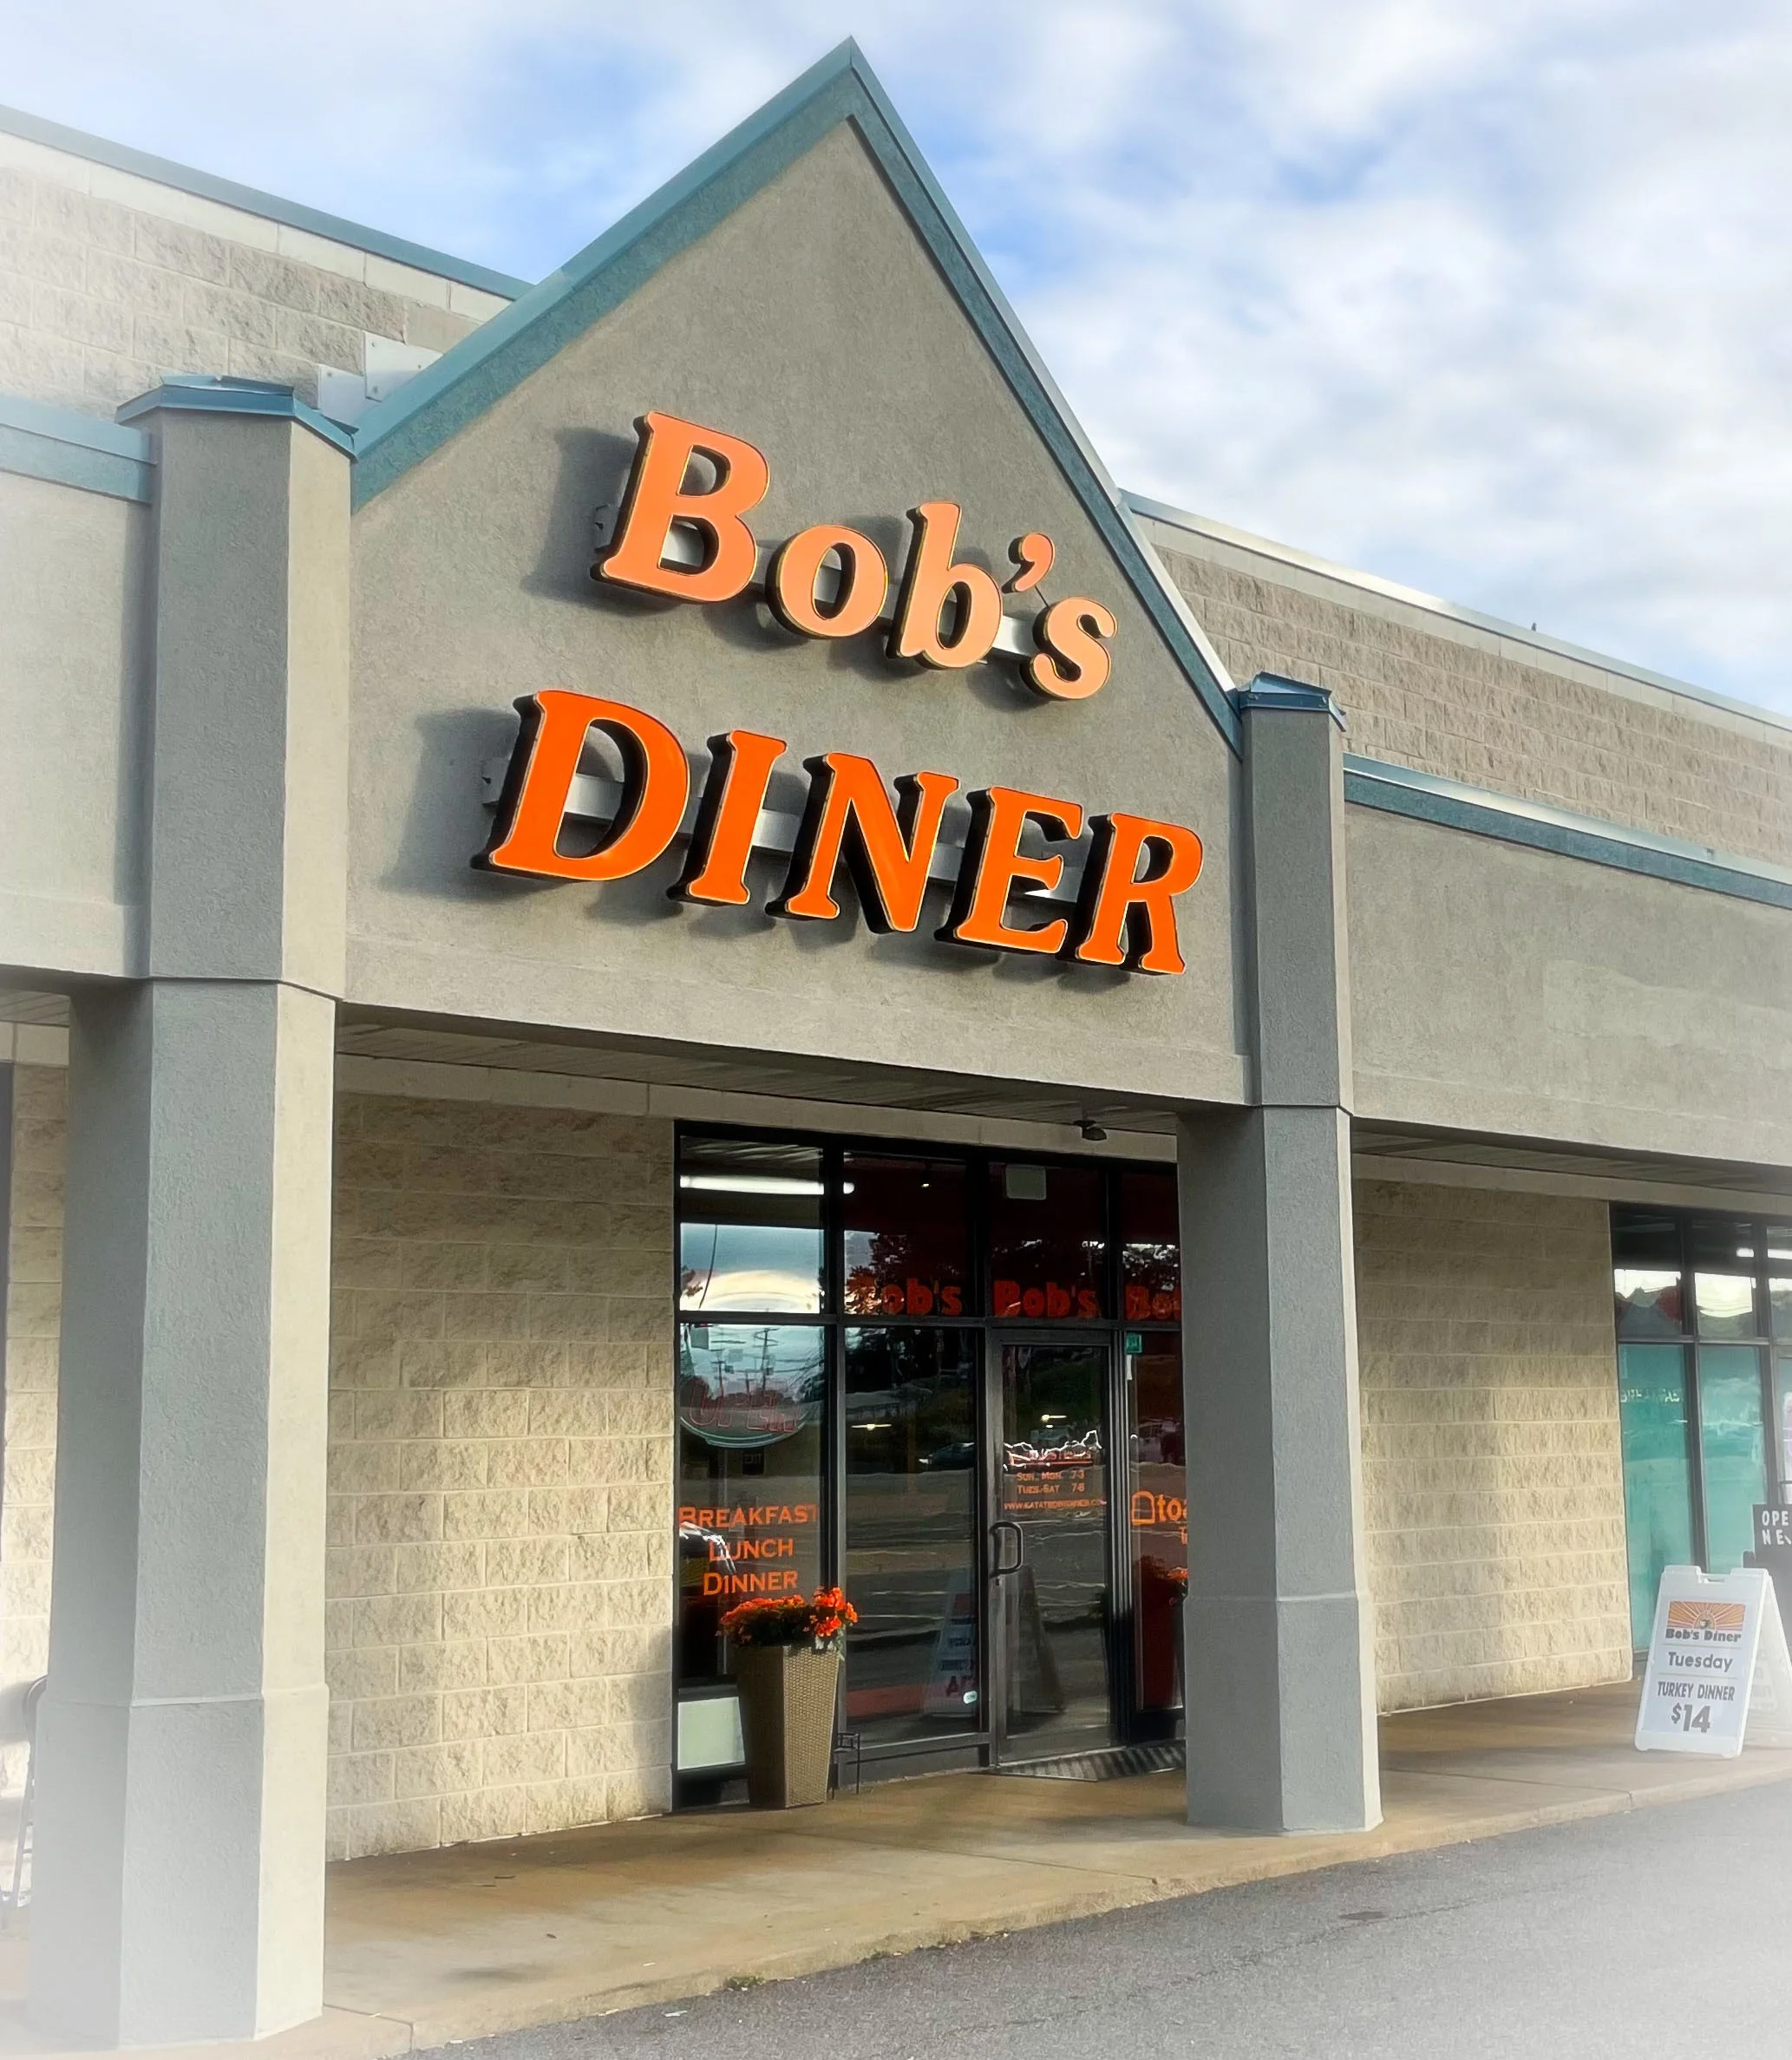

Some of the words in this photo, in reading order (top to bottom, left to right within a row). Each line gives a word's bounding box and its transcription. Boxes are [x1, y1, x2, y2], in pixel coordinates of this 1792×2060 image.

[598, 410, 1118, 701] Bob's
[486, 690, 1204, 975] DINER
[993, 1279, 1098, 1318] Bob's
[678, 1503, 819, 1529] BREAKFAST
[1156, 1494, 1187, 1522] to
[709, 1538, 795, 1562] LUNCH
[703, 1570, 799, 1596] DINNER
[1664, 1628, 1700, 1641] Bob's
[1704, 1630, 1742, 1643] Diner
[1668, 1651, 1733, 1672] Tuesday
[1658, 1681, 1694, 1699] TURKEY
[1697, 1684, 1736, 1701] DINNER
[1671, 1702, 1710, 1733] $14
